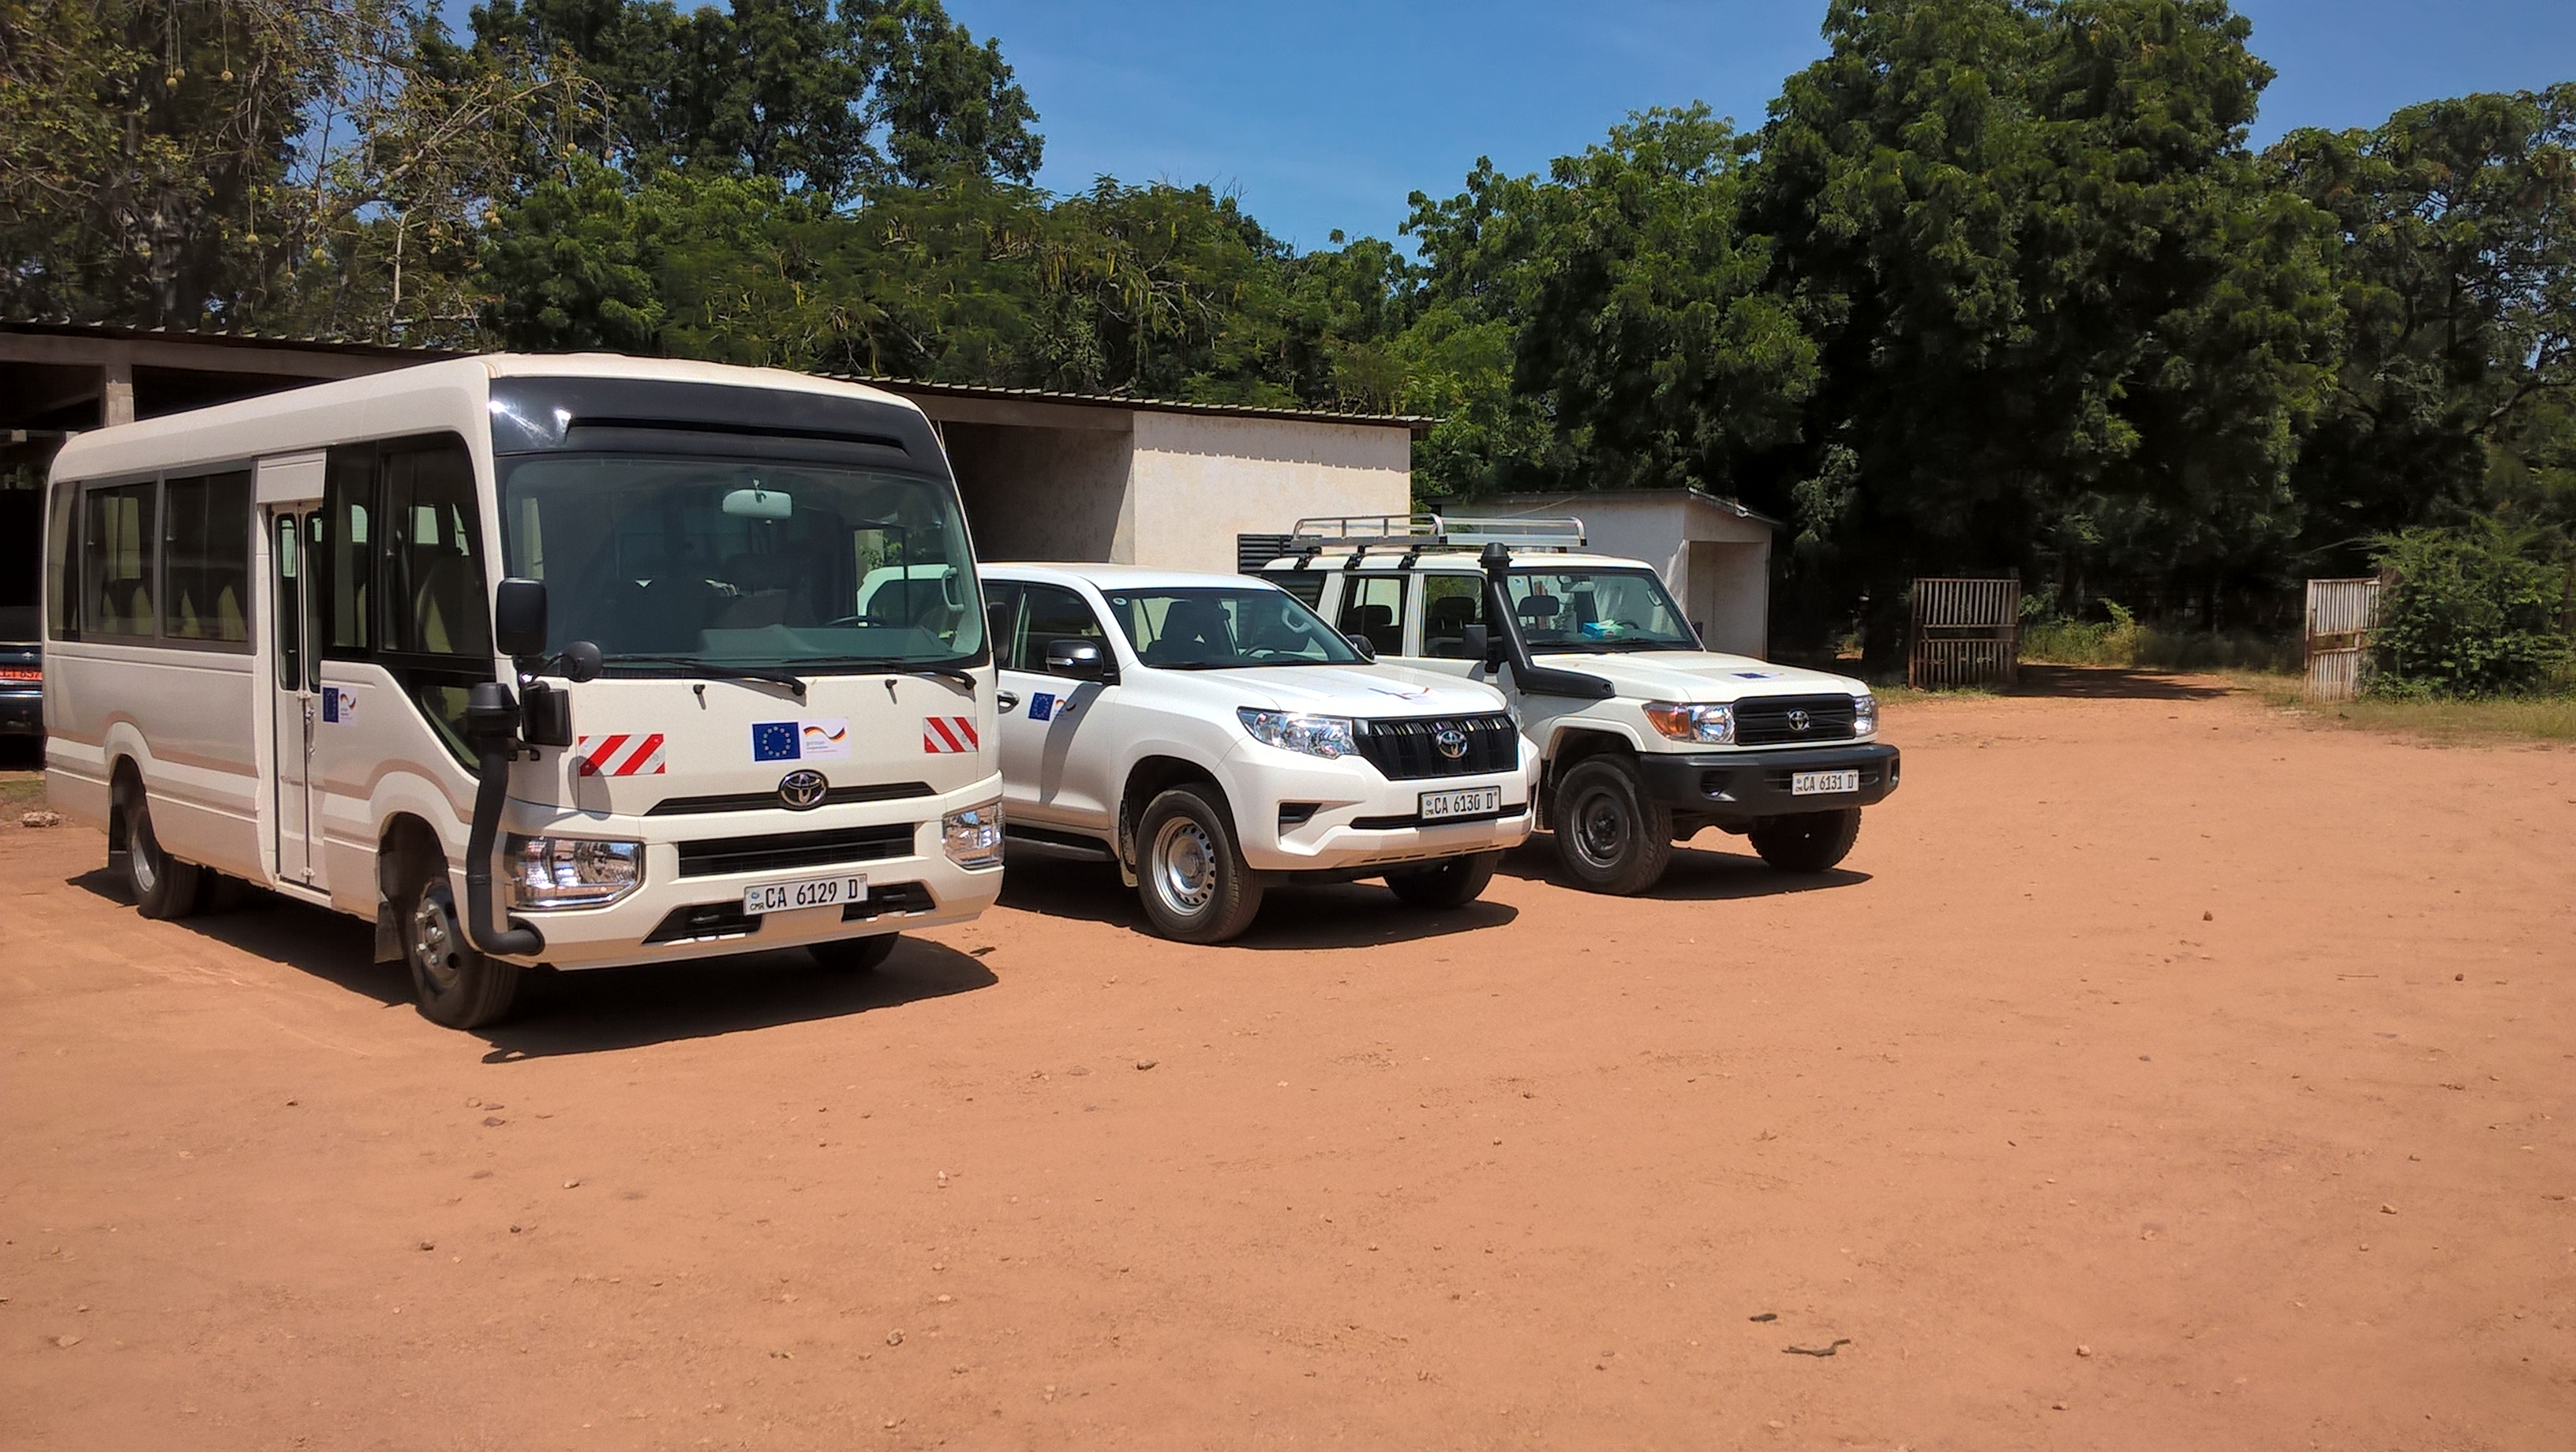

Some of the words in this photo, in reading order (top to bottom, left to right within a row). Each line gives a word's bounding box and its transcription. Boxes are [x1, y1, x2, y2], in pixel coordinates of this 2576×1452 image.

[1803, 777, 1815, 791] CA
[1819, 775, 1842, 790] 6131
[1848, 774, 1854, 788] D
[1435, 797, 1448, 814] CA
[1454, 794, 1480, 812] 6130
[1486, 793, 1492, 809] D
[766, 887, 787, 908] CA
[796, 881, 837, 905] 6129
[848, 879, 858, 899] D
